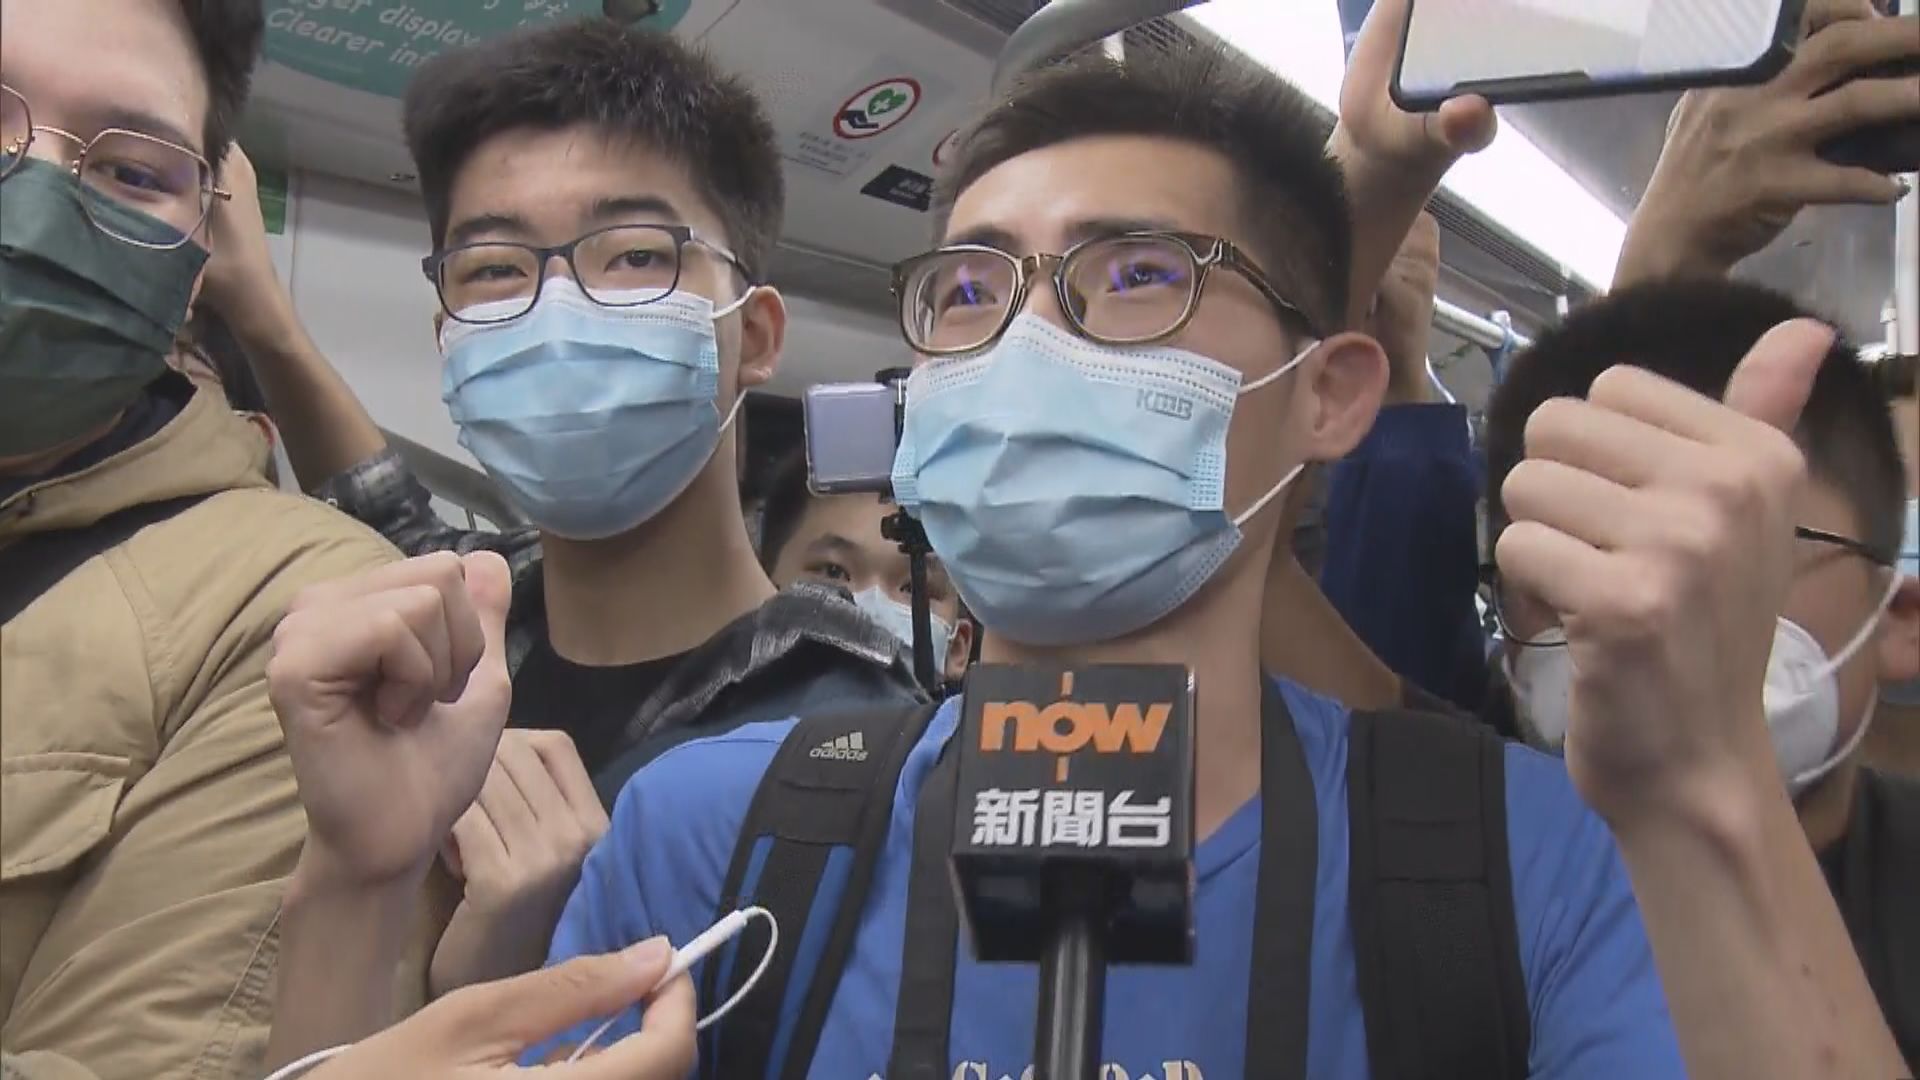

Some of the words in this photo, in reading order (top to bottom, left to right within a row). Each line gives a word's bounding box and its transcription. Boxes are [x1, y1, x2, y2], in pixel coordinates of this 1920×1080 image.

[266, 8, 384, 53] Clearer
[980, 700, 1173, 753] now
[809, 747, 869, 761] adidas
[970, 788, 1172, 848] 新聞台
